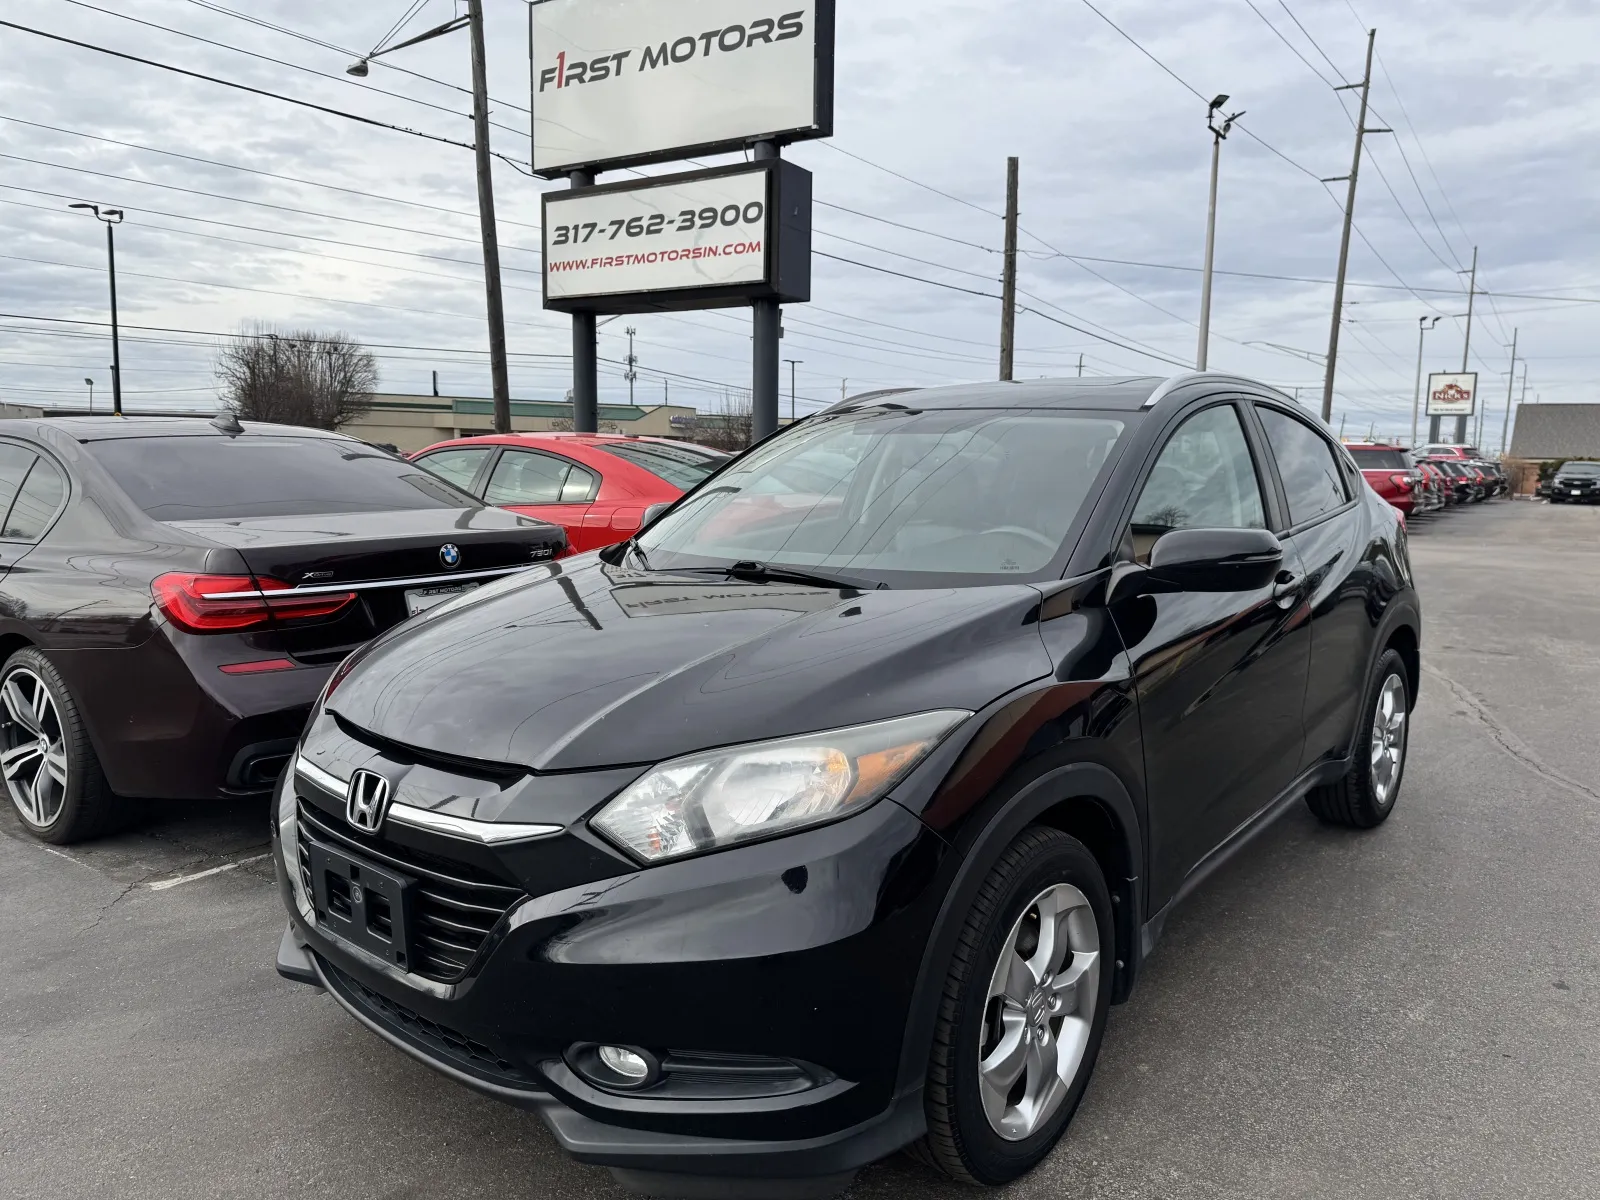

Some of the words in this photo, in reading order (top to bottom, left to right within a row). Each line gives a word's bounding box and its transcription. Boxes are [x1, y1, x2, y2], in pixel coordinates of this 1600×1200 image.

[638, 10, 805, 72] MOTORS
[552, 201, 764, 246] 317-762-3900
[549, 241, 762, 273] WWW.FIRSTMOTORSIN.COM
